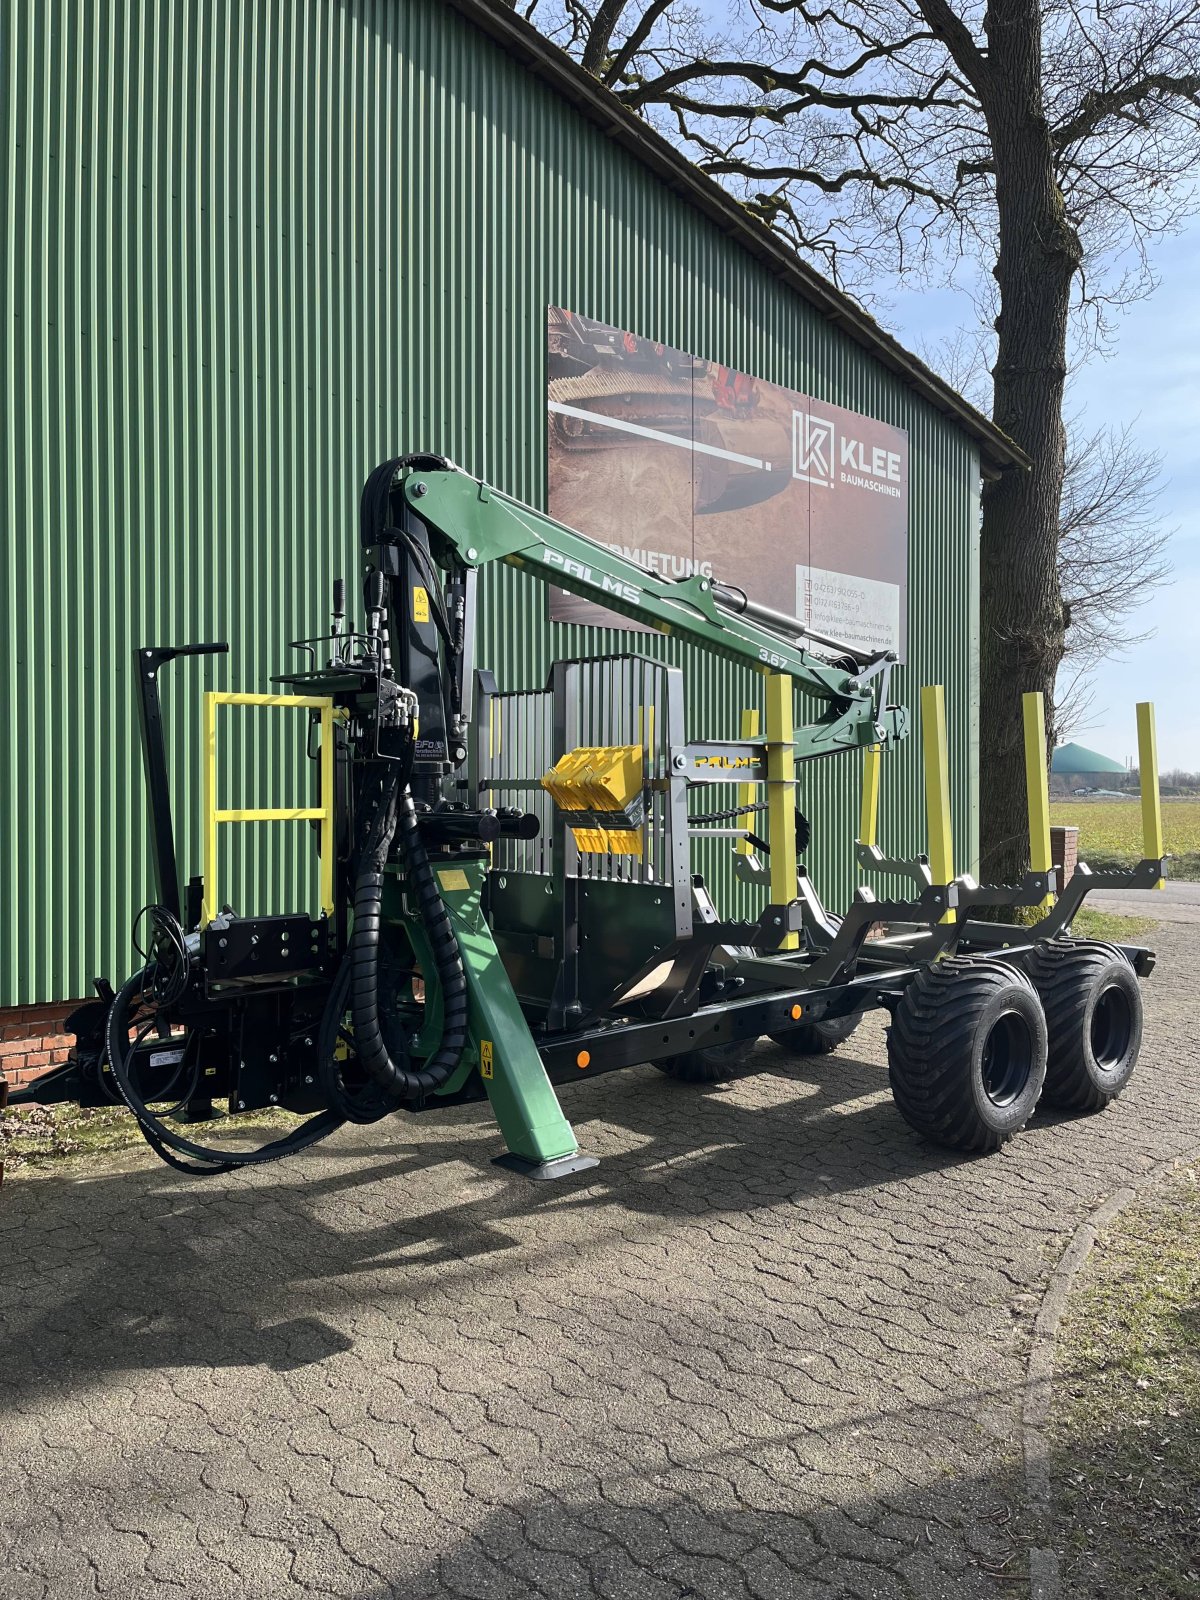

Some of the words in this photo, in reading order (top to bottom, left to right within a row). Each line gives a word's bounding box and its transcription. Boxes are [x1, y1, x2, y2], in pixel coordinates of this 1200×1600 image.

[841, 436, 900, 482] KLEE
[841, 472, 900, 498] BAUMASCHINEN
[543, 548, 641, 605] PALMS
[758, 648, 788, 669] 3.67
[694, 755, 762, 769] PALMS
